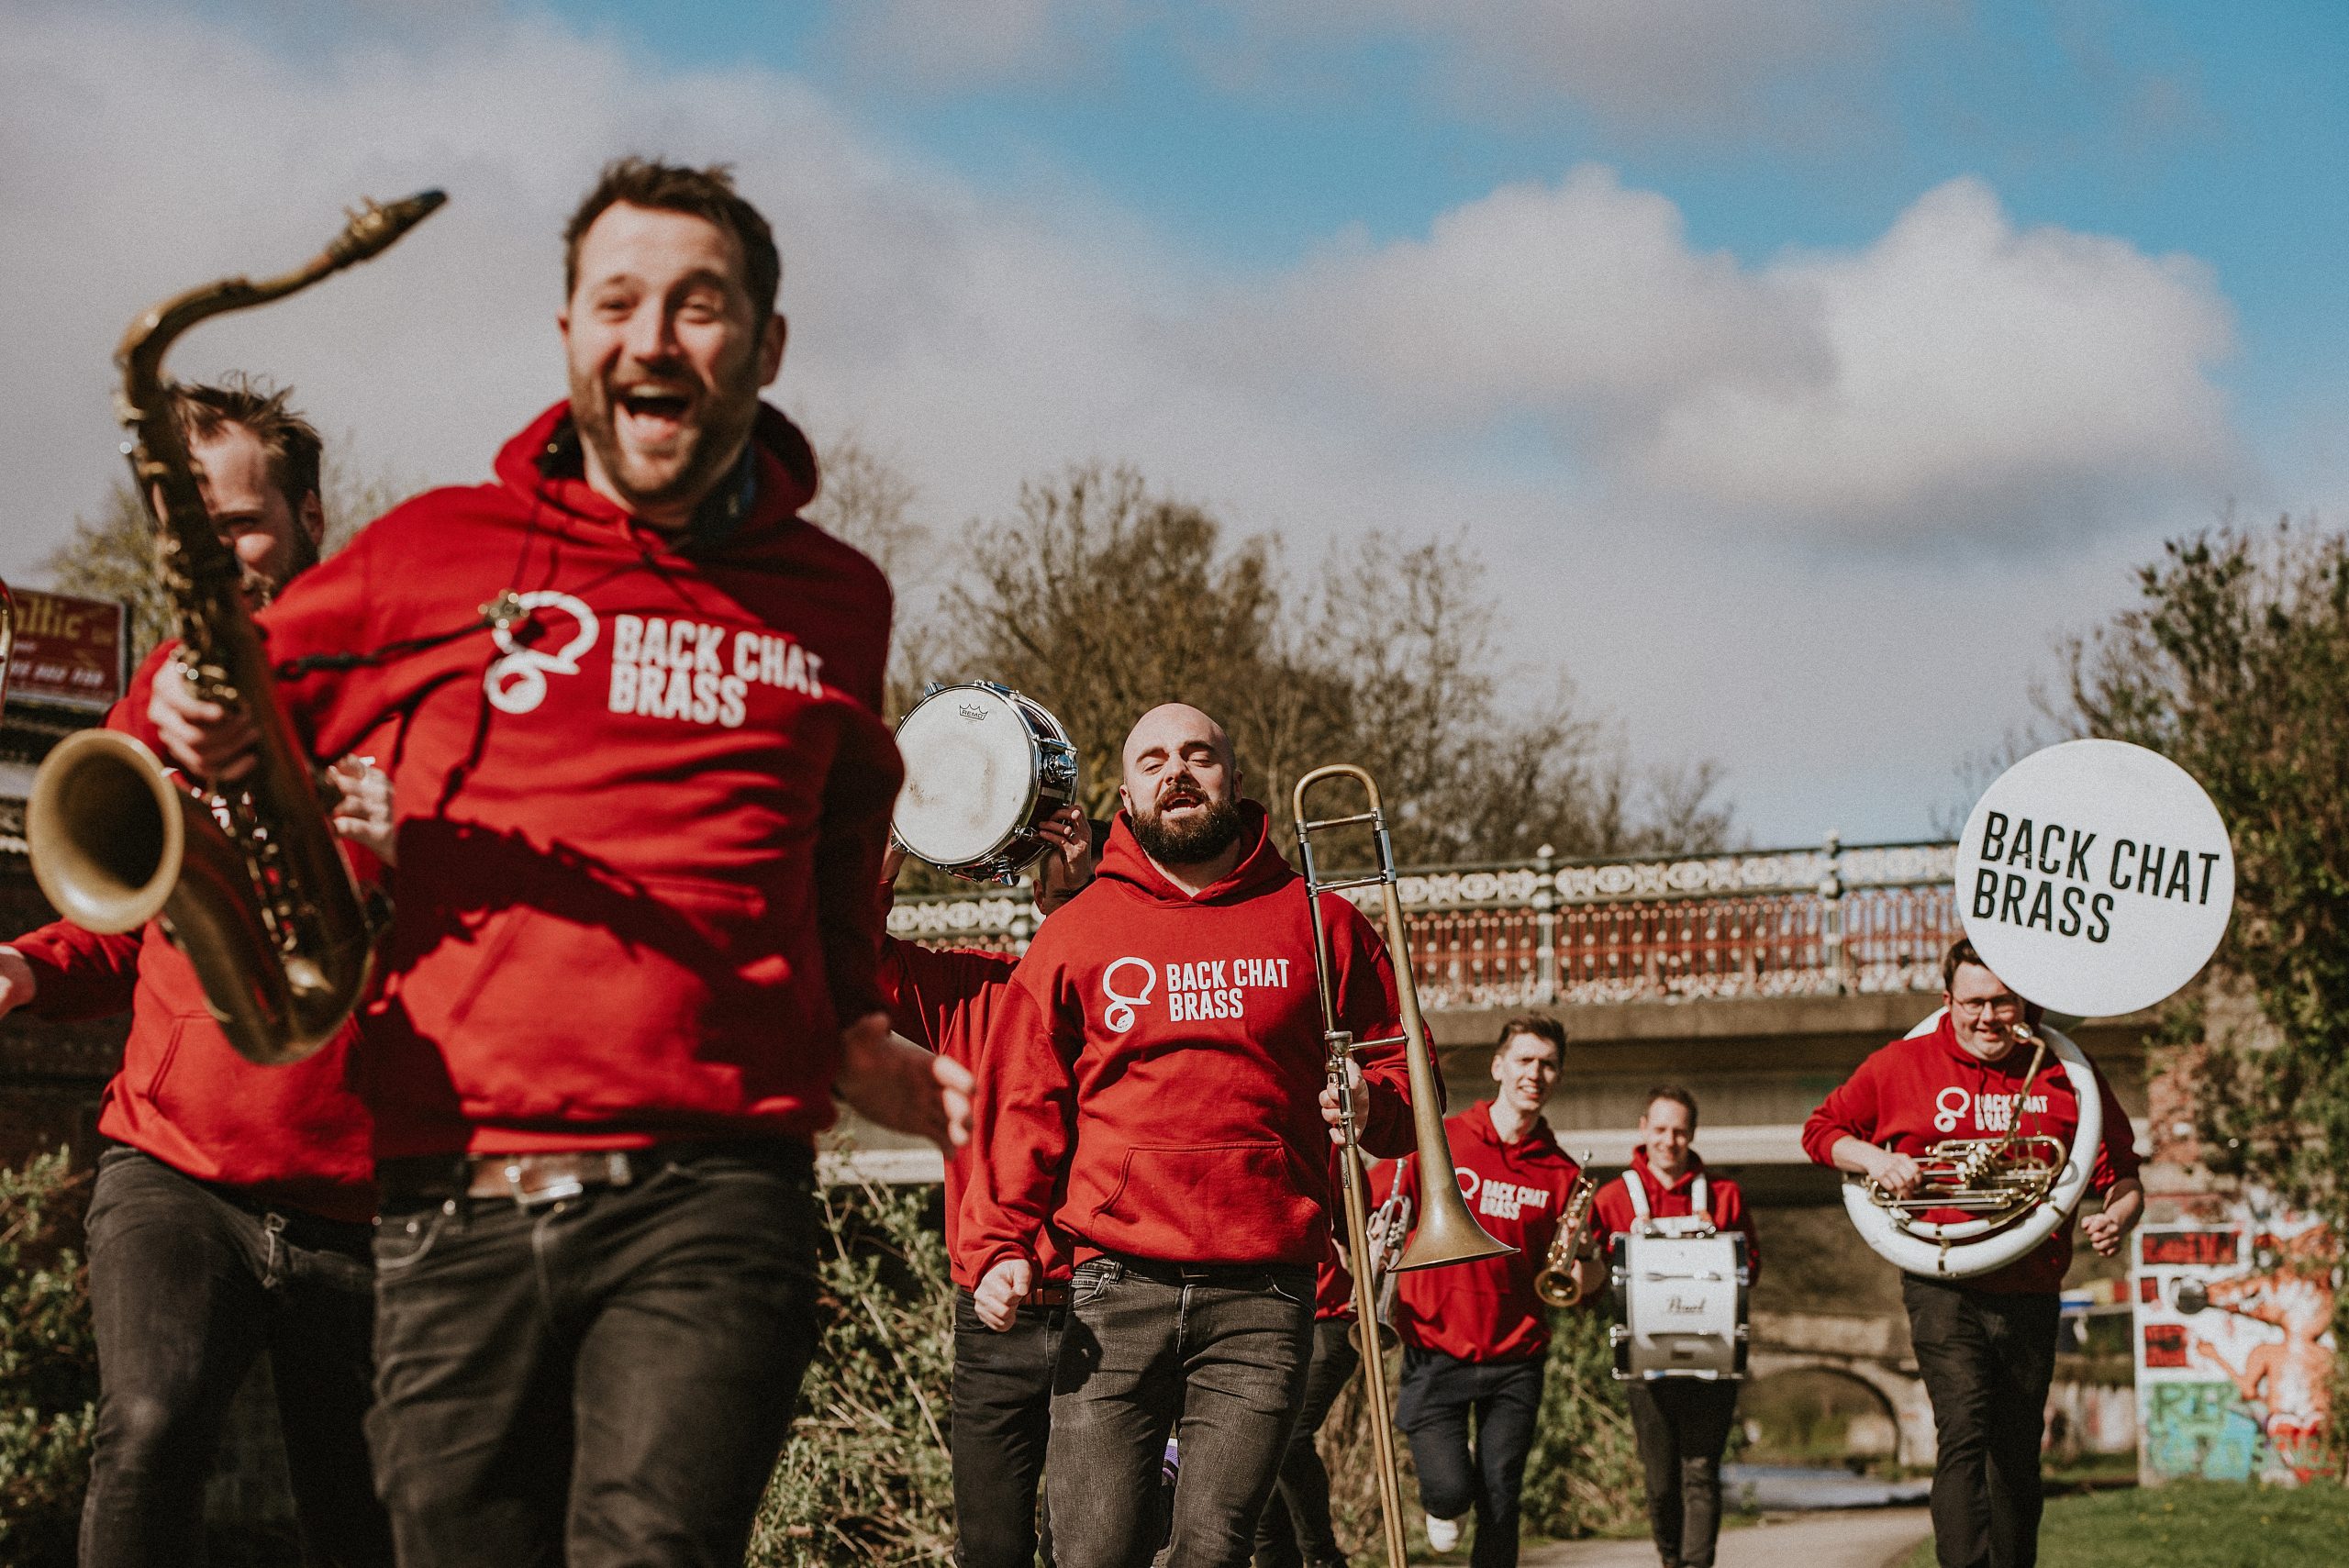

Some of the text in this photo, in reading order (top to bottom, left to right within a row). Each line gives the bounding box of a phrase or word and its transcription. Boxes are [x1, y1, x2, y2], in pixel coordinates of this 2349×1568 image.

[613, 614, 823, 699] BACK CHAT
[607, 662, 747, 728] BRASS
[962, 709, 983, 719] REMO
[1980, 810, 2221, 906] BACK CHAT
[1972, 867, 2114, 944] BRASS
[1165, 958, 1289, 992] BACK CHAT
[1168, 988, 1243, 1022] BRASS
[1517, 1185, 1551, 1209] CHAT
